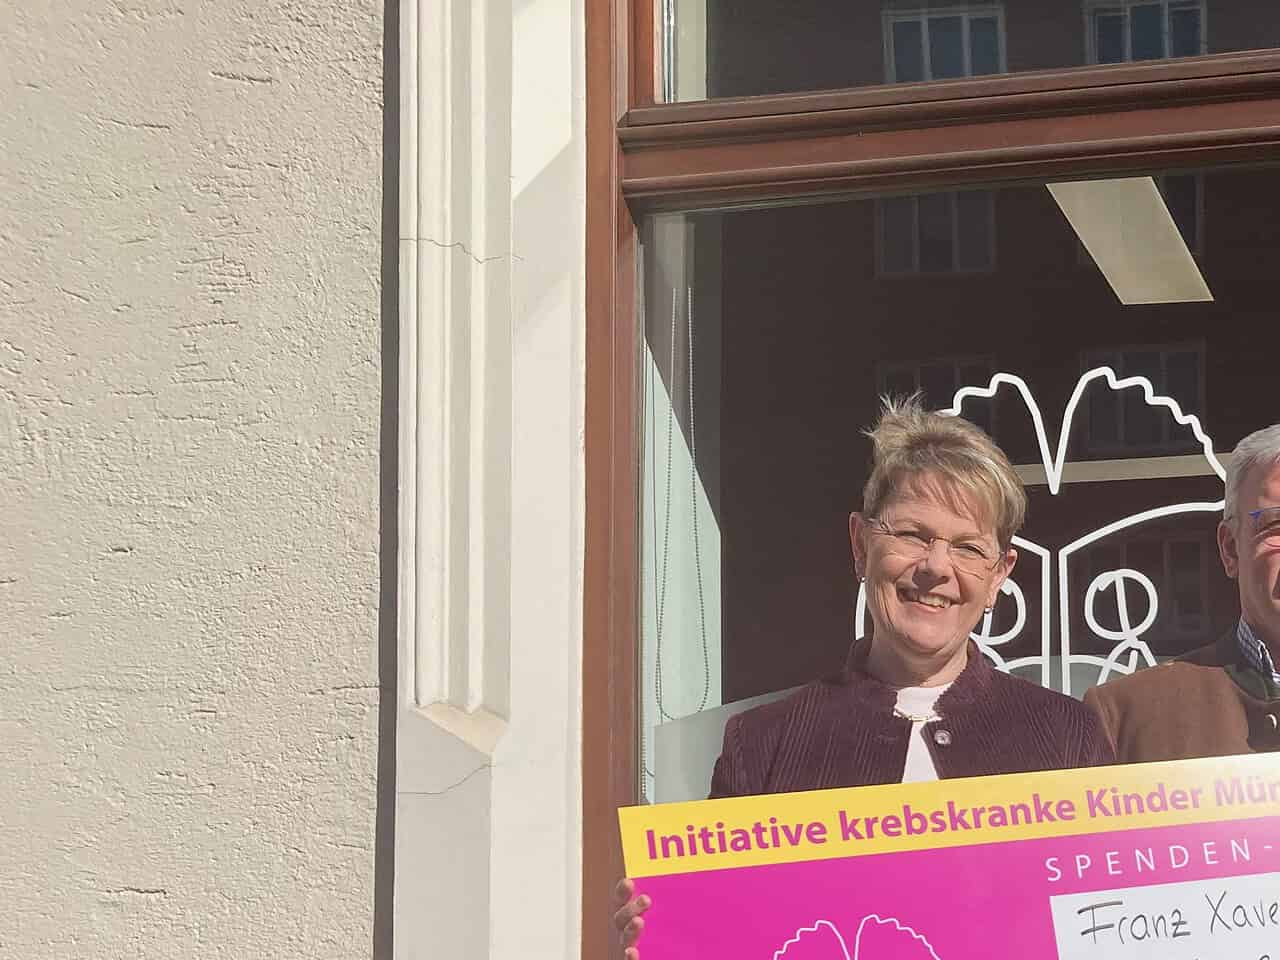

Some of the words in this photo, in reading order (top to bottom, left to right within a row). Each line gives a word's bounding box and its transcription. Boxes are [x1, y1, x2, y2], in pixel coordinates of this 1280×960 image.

[645, 814, 828, 860] Initiative
[839, 795, 1076, 843] krebskranke
[1086, 785, 1202, 819] Kinder
[1077, 900, 1192, 945] Franz
